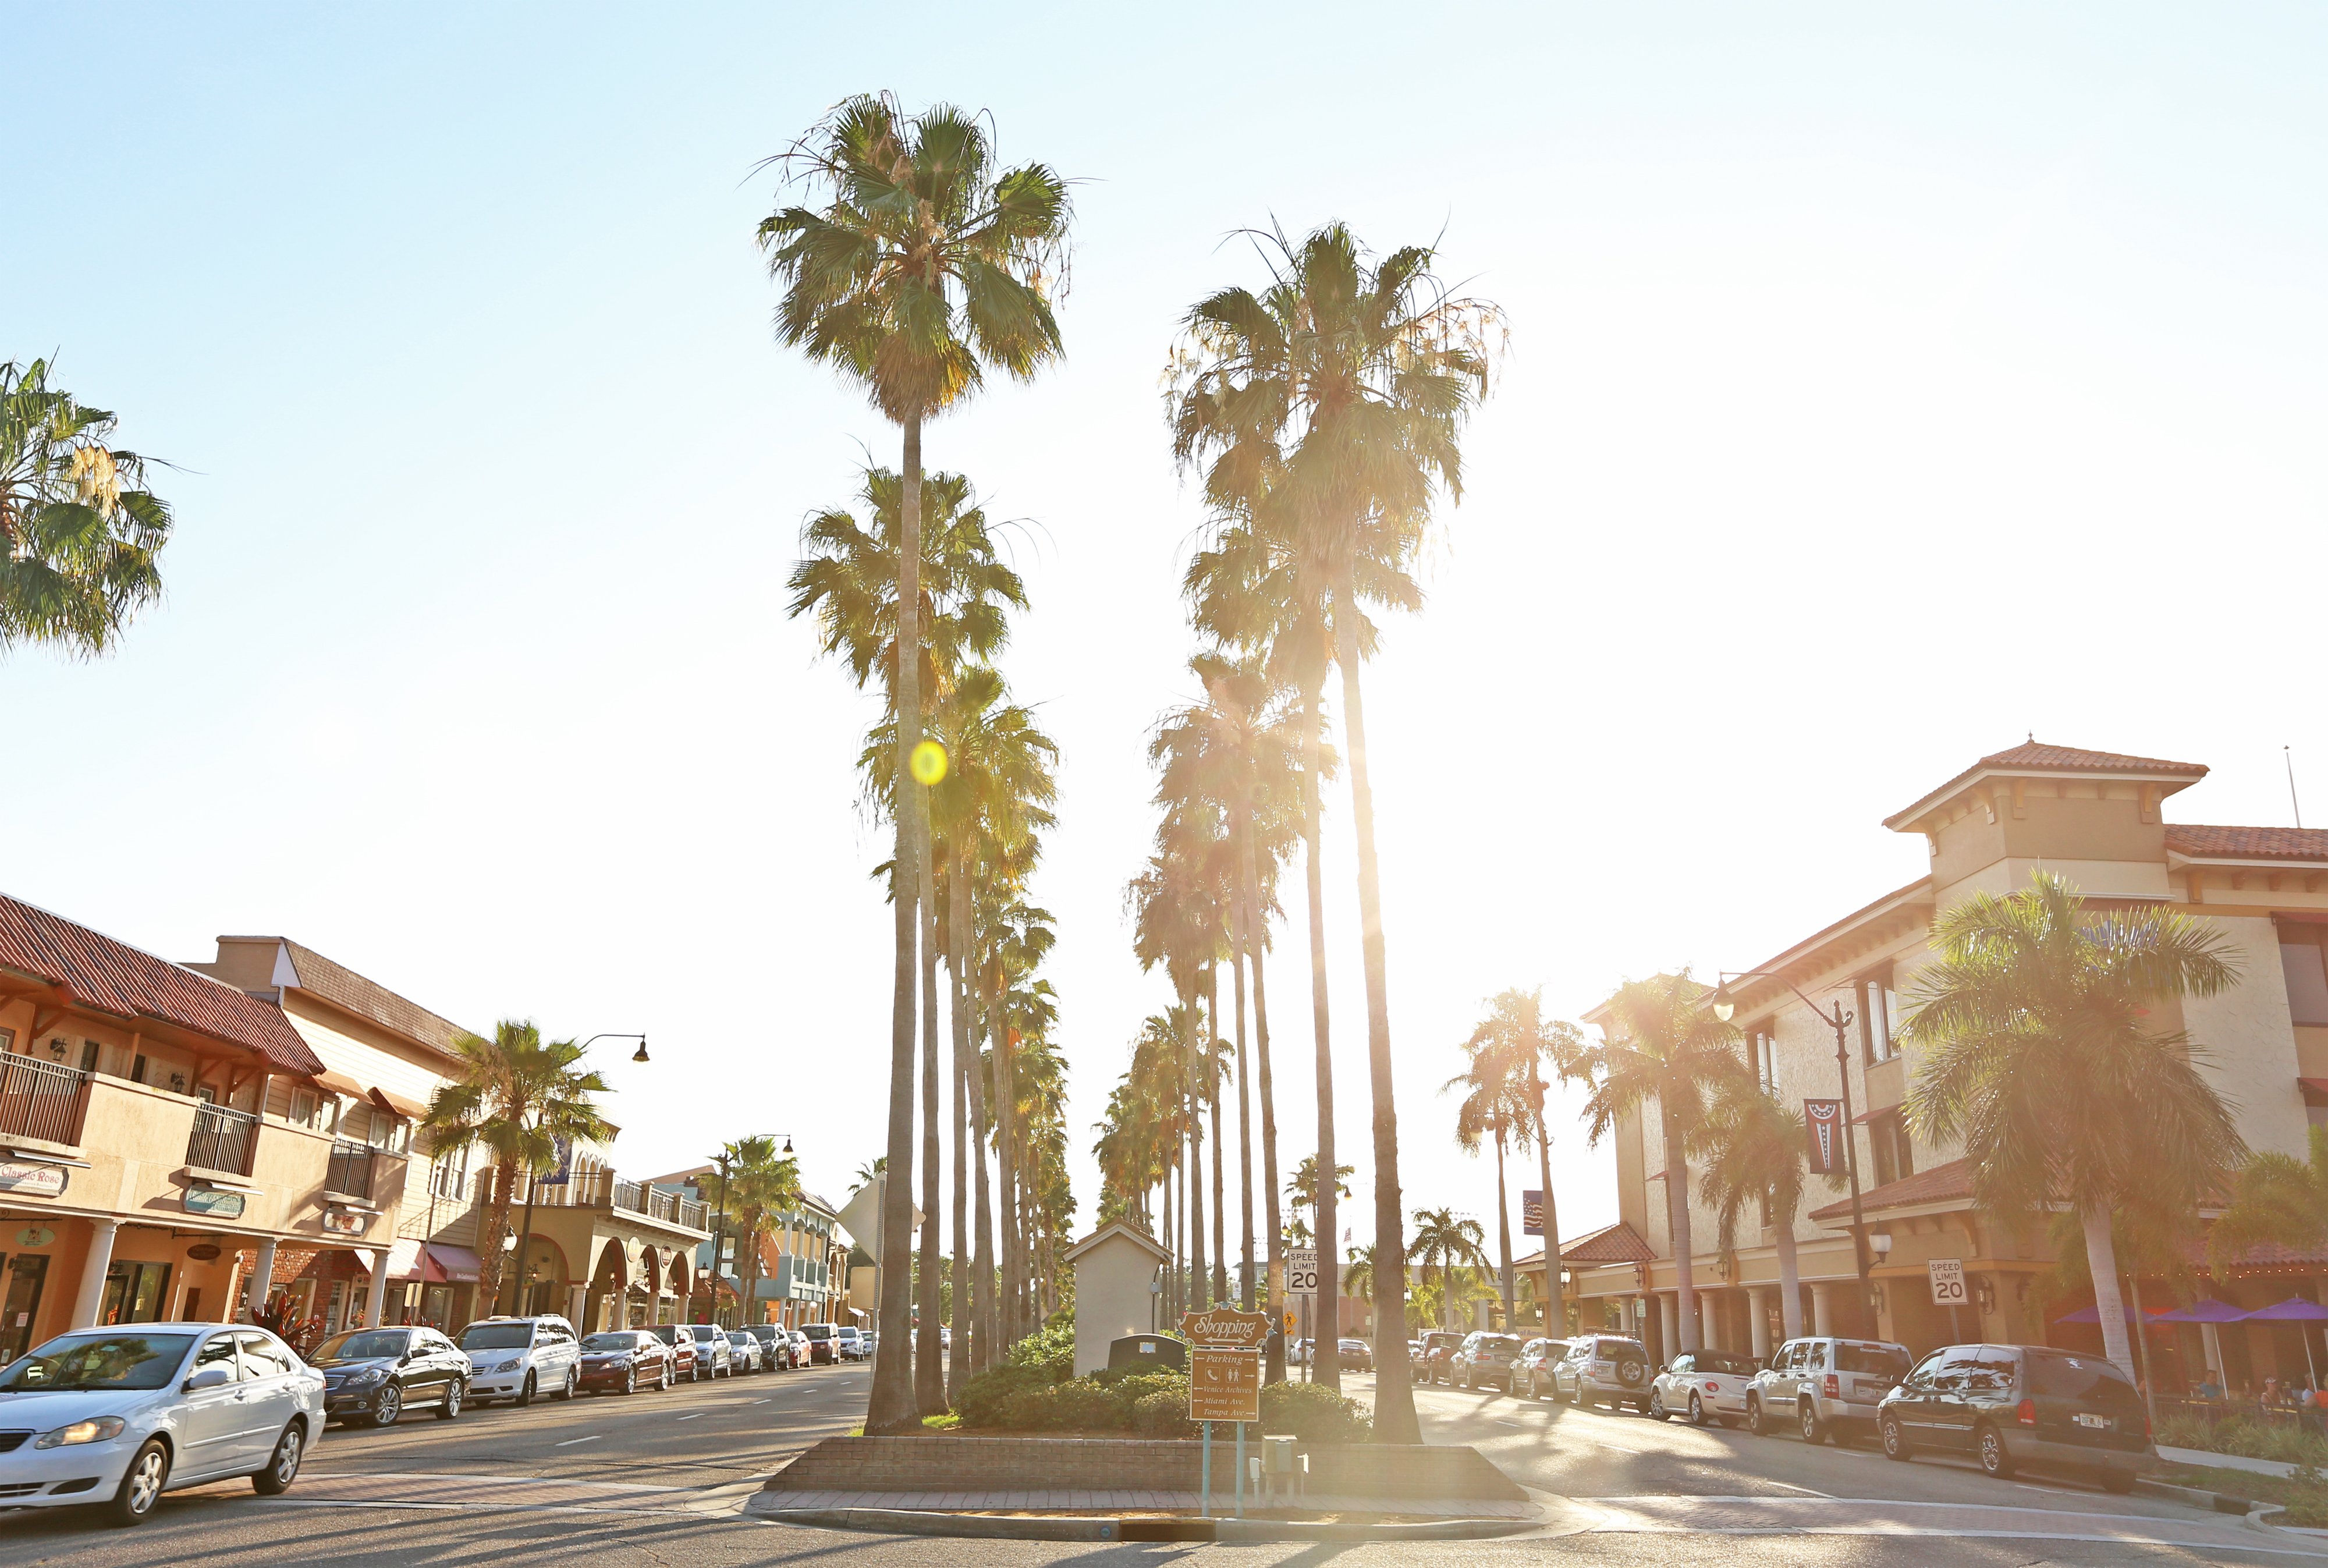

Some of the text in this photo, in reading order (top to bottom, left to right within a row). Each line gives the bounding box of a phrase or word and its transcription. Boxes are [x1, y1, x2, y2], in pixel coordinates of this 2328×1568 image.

[1, 1166, 59, 1184] Classic Rose
[1291, 1272, 1318, 1289] 20
[1936, 1282, 1963, 1299] 20
[1194, 1314, 1256, 1338] Shopping
[1206, 1355, 1243, 1365] Parking
[1204, 1409, 1228, 1417] Tampa
